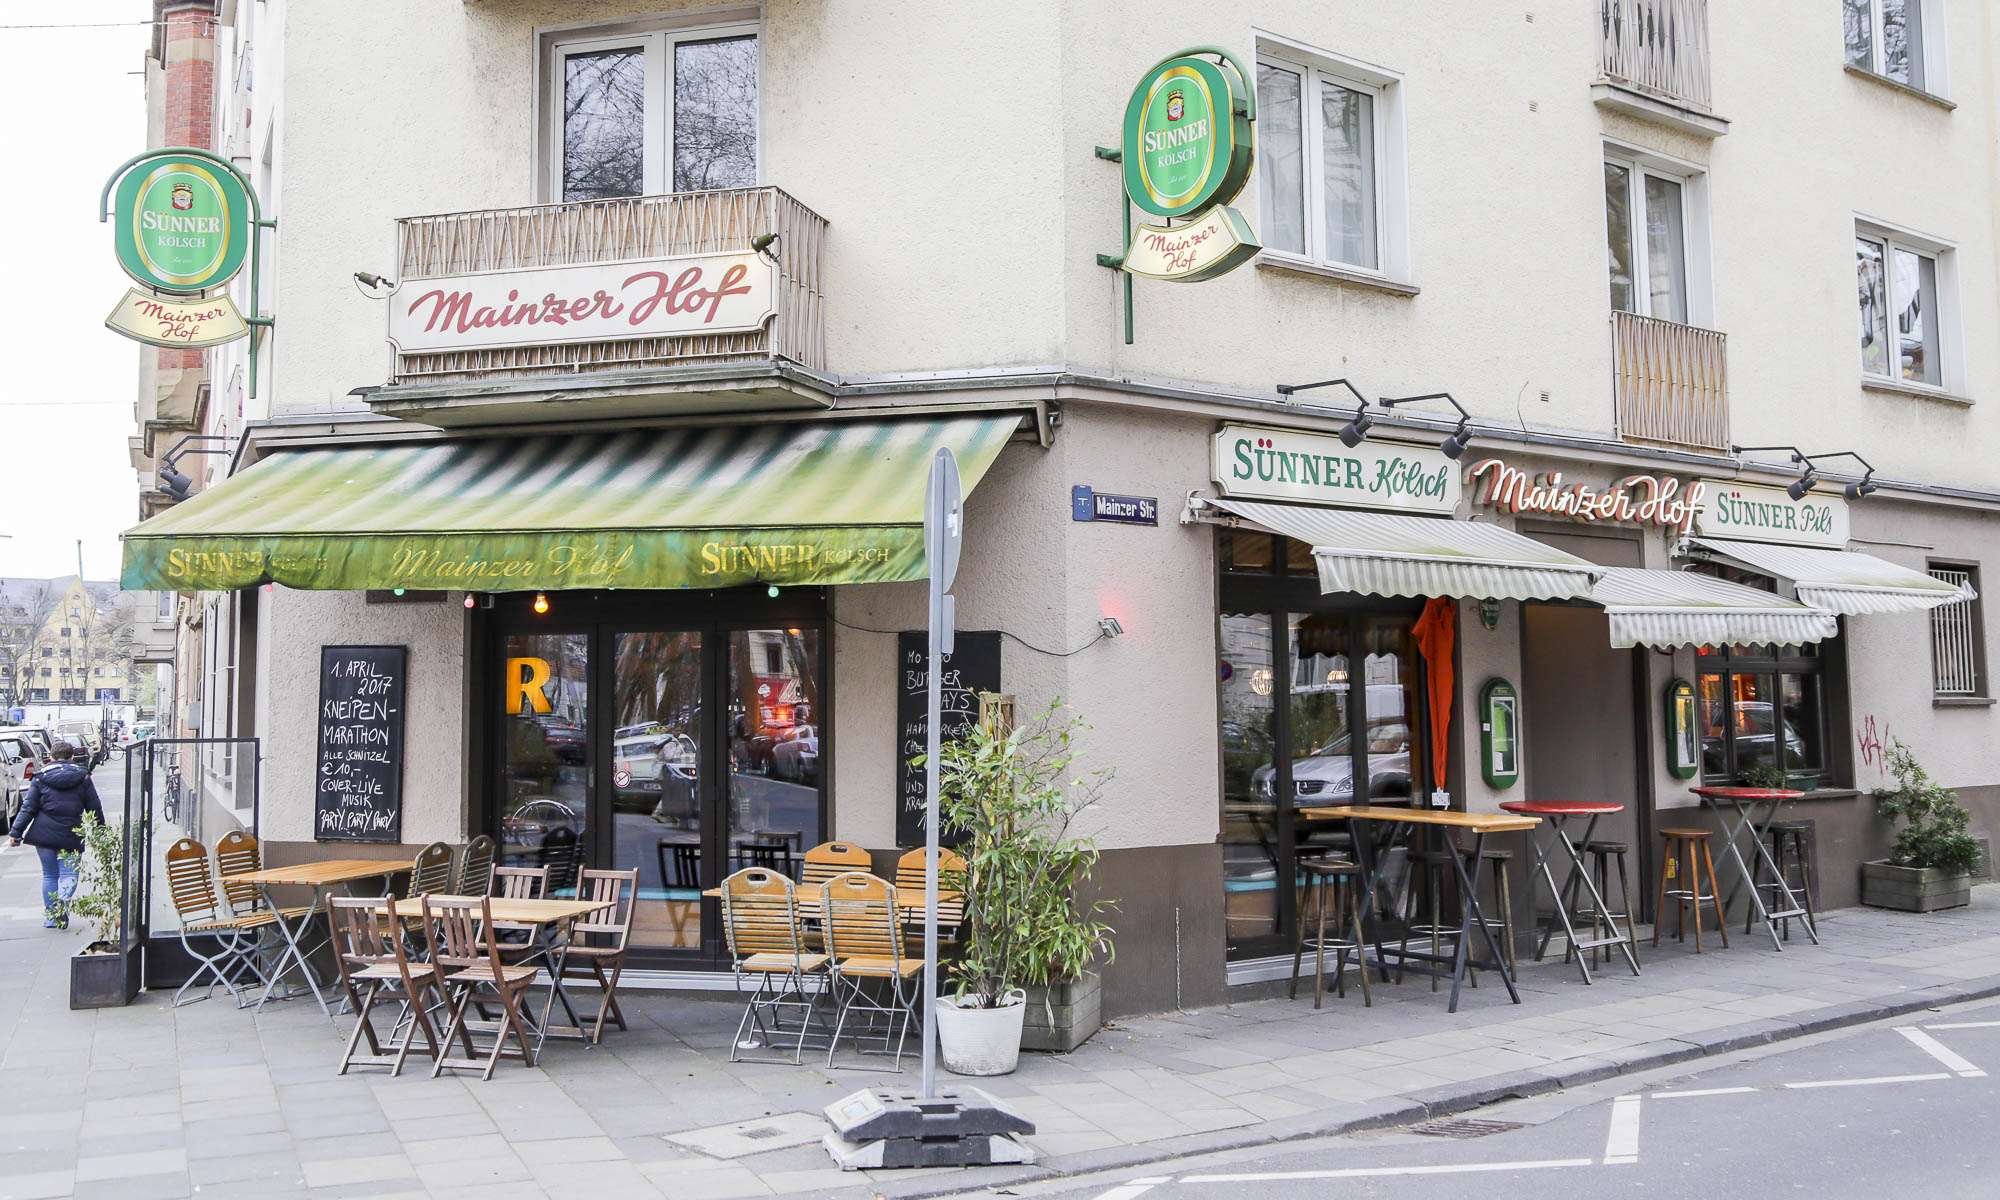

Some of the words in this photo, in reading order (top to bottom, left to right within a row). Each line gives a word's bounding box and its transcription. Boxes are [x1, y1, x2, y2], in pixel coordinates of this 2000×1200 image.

[1145, 119, 1208, 153] SÜNNER
[143, 210, 220, 233] SÜNNER
[1144, 224, 1219, 253] Mainzer
[1163, 251, 1197, 273] Hof
[135, 300, 226, 322] Mainzer
[408, 287, 624, 335] Mainzer
[621, 264, 752, 326] Hof
[158, 322, 199, 341] Hof
[1233, 438, 1365, 490] SÜNNER
[1369, 457, 1448, 502] Kölsch
[1096, 496, 1137, 517] Mainzer
[1140, 500, 1155, 519] Str.
[1473, 459, 1636, 521] Mainzer
[1627, 474, 1705, 535] Hof
[1717, 491, 1798, 530] SÜNNER
[1800, 504, 1832, 535] Pils
[392, 548, 537, 577] Mainzer
[701, 541, 819, 575] SÜNNER
[907, 650, 921, 664] MO
[345, 660, 383, 678] APRIL
[357, 676, 393, 696] 2017
[506, 656, 553, 714] R
[323, 724, 389, 746] MARATHON
[323, 750, 344, 761] ALLE
[345, 747, 390, 763] SCHNITZEL
[905, 781, 924, 794] UND
[341, 794, 372, 809] MUSIK
